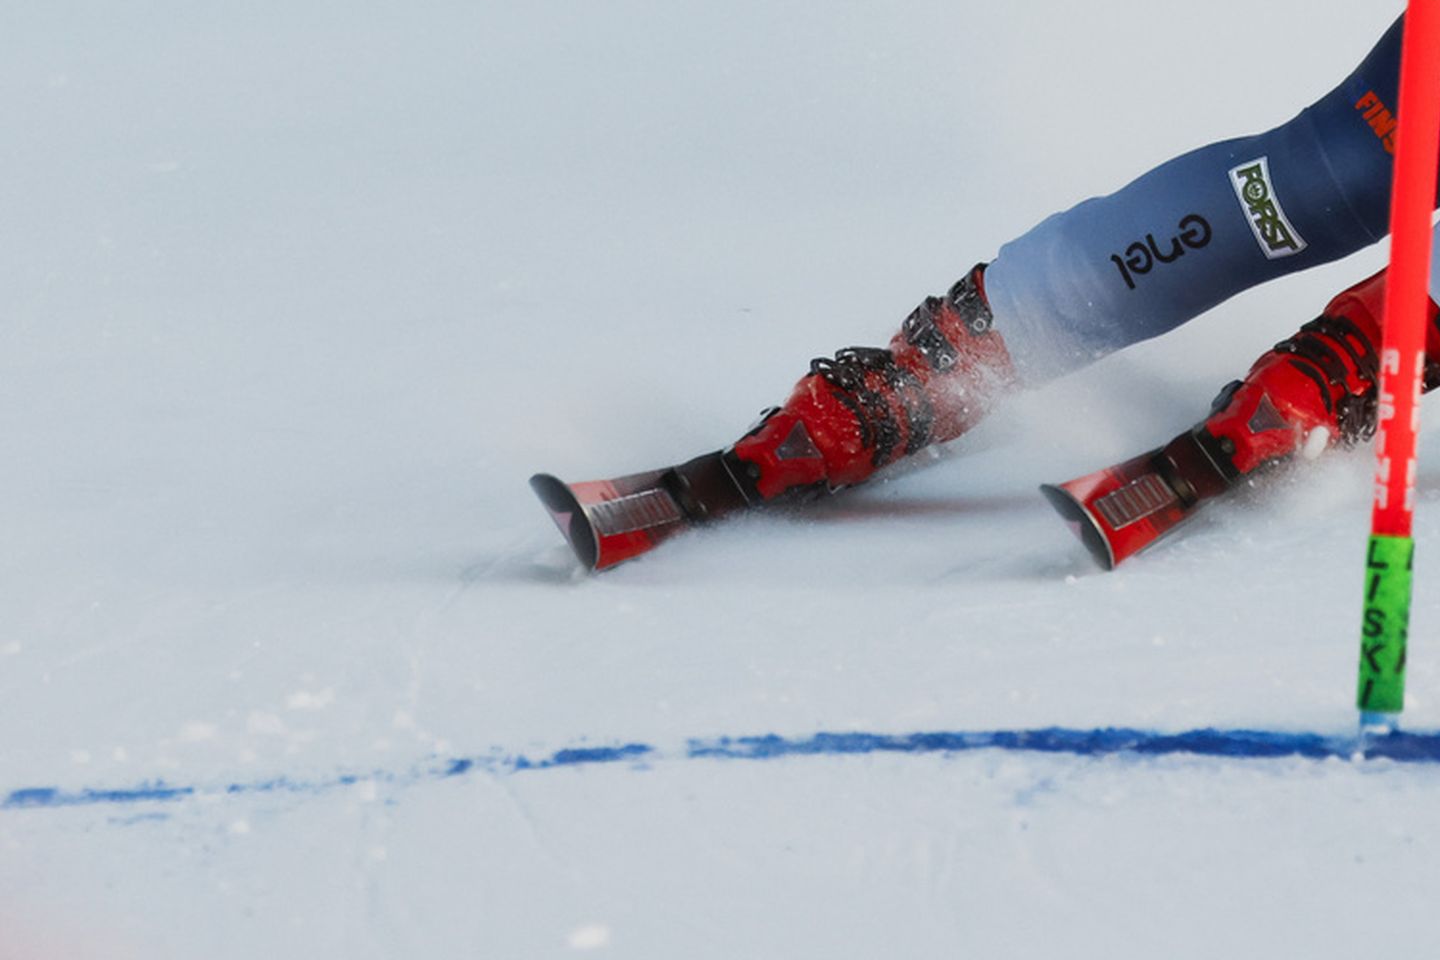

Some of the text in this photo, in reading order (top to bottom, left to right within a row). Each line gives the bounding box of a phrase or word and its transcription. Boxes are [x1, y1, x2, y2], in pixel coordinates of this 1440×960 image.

[1110, 213, 1212, 290] enel
[1236, 162, 1299, 252] FORST
[1362, 540, 1389, 709] LISKI
